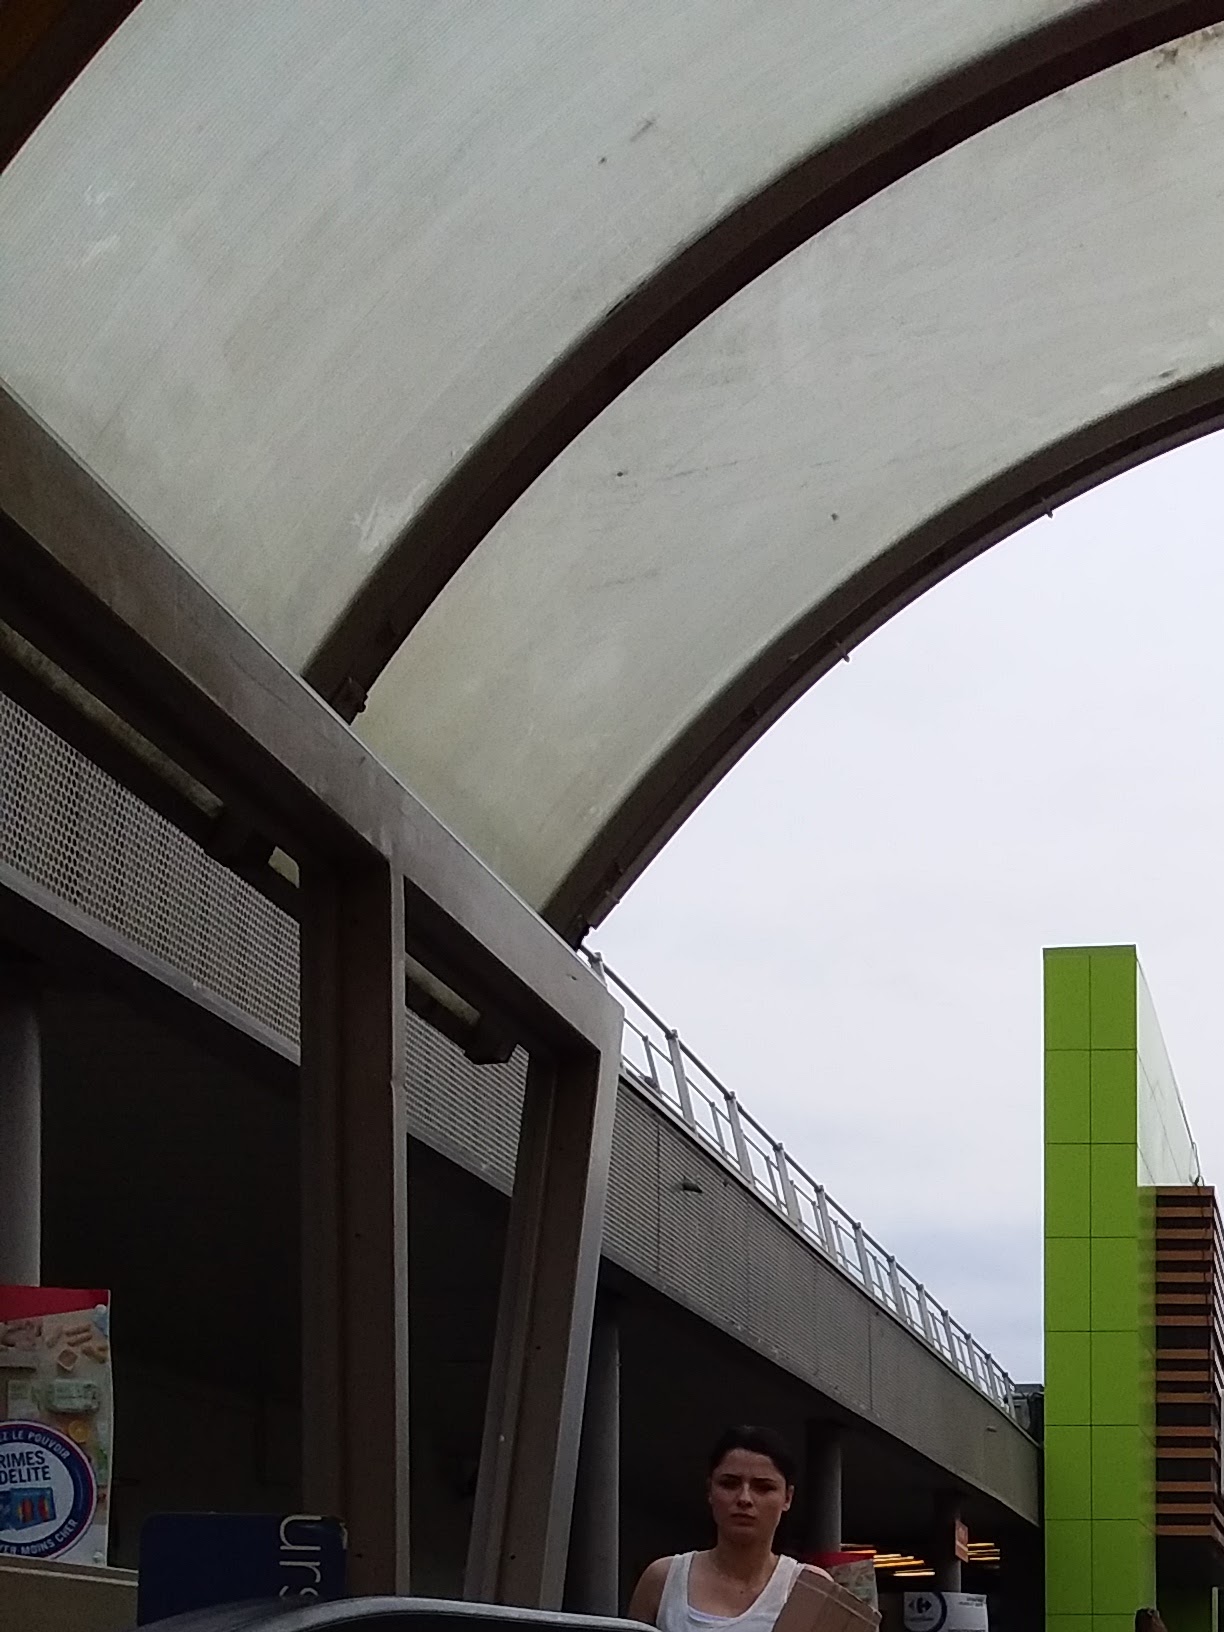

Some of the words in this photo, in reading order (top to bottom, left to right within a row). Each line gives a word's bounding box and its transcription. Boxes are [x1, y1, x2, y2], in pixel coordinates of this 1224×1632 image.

[12, 1429, 24, 1441] LE
[28, 1430, 71, 1460] POUVOIR
[21, 1540, 56, 1556] MOINS
[54, 1518, 79, 1541] CHER
